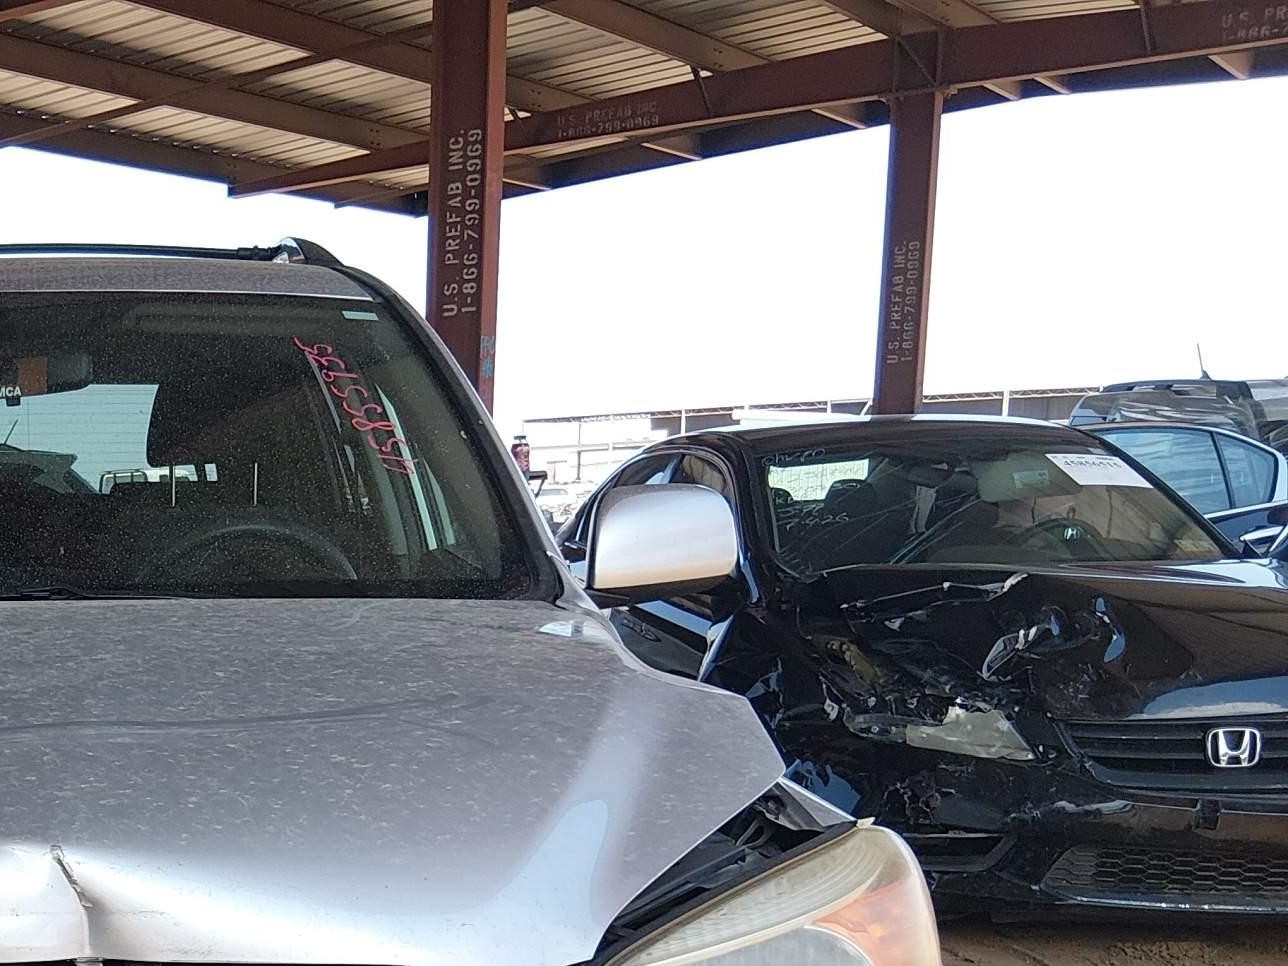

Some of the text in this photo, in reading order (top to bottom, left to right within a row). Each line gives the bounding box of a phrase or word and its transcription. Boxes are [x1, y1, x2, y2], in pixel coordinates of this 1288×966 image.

[448, 129, 465, 171] INC.
[444, 181, 462, 265] PREFAB
[460, 128, 482, 313] 1-866-799-0969
[894, 241, 907, 268] INC.
[889, 275, 905, 330] PREFAB
[900, 240, 921, 361] 1-866-799-0969
